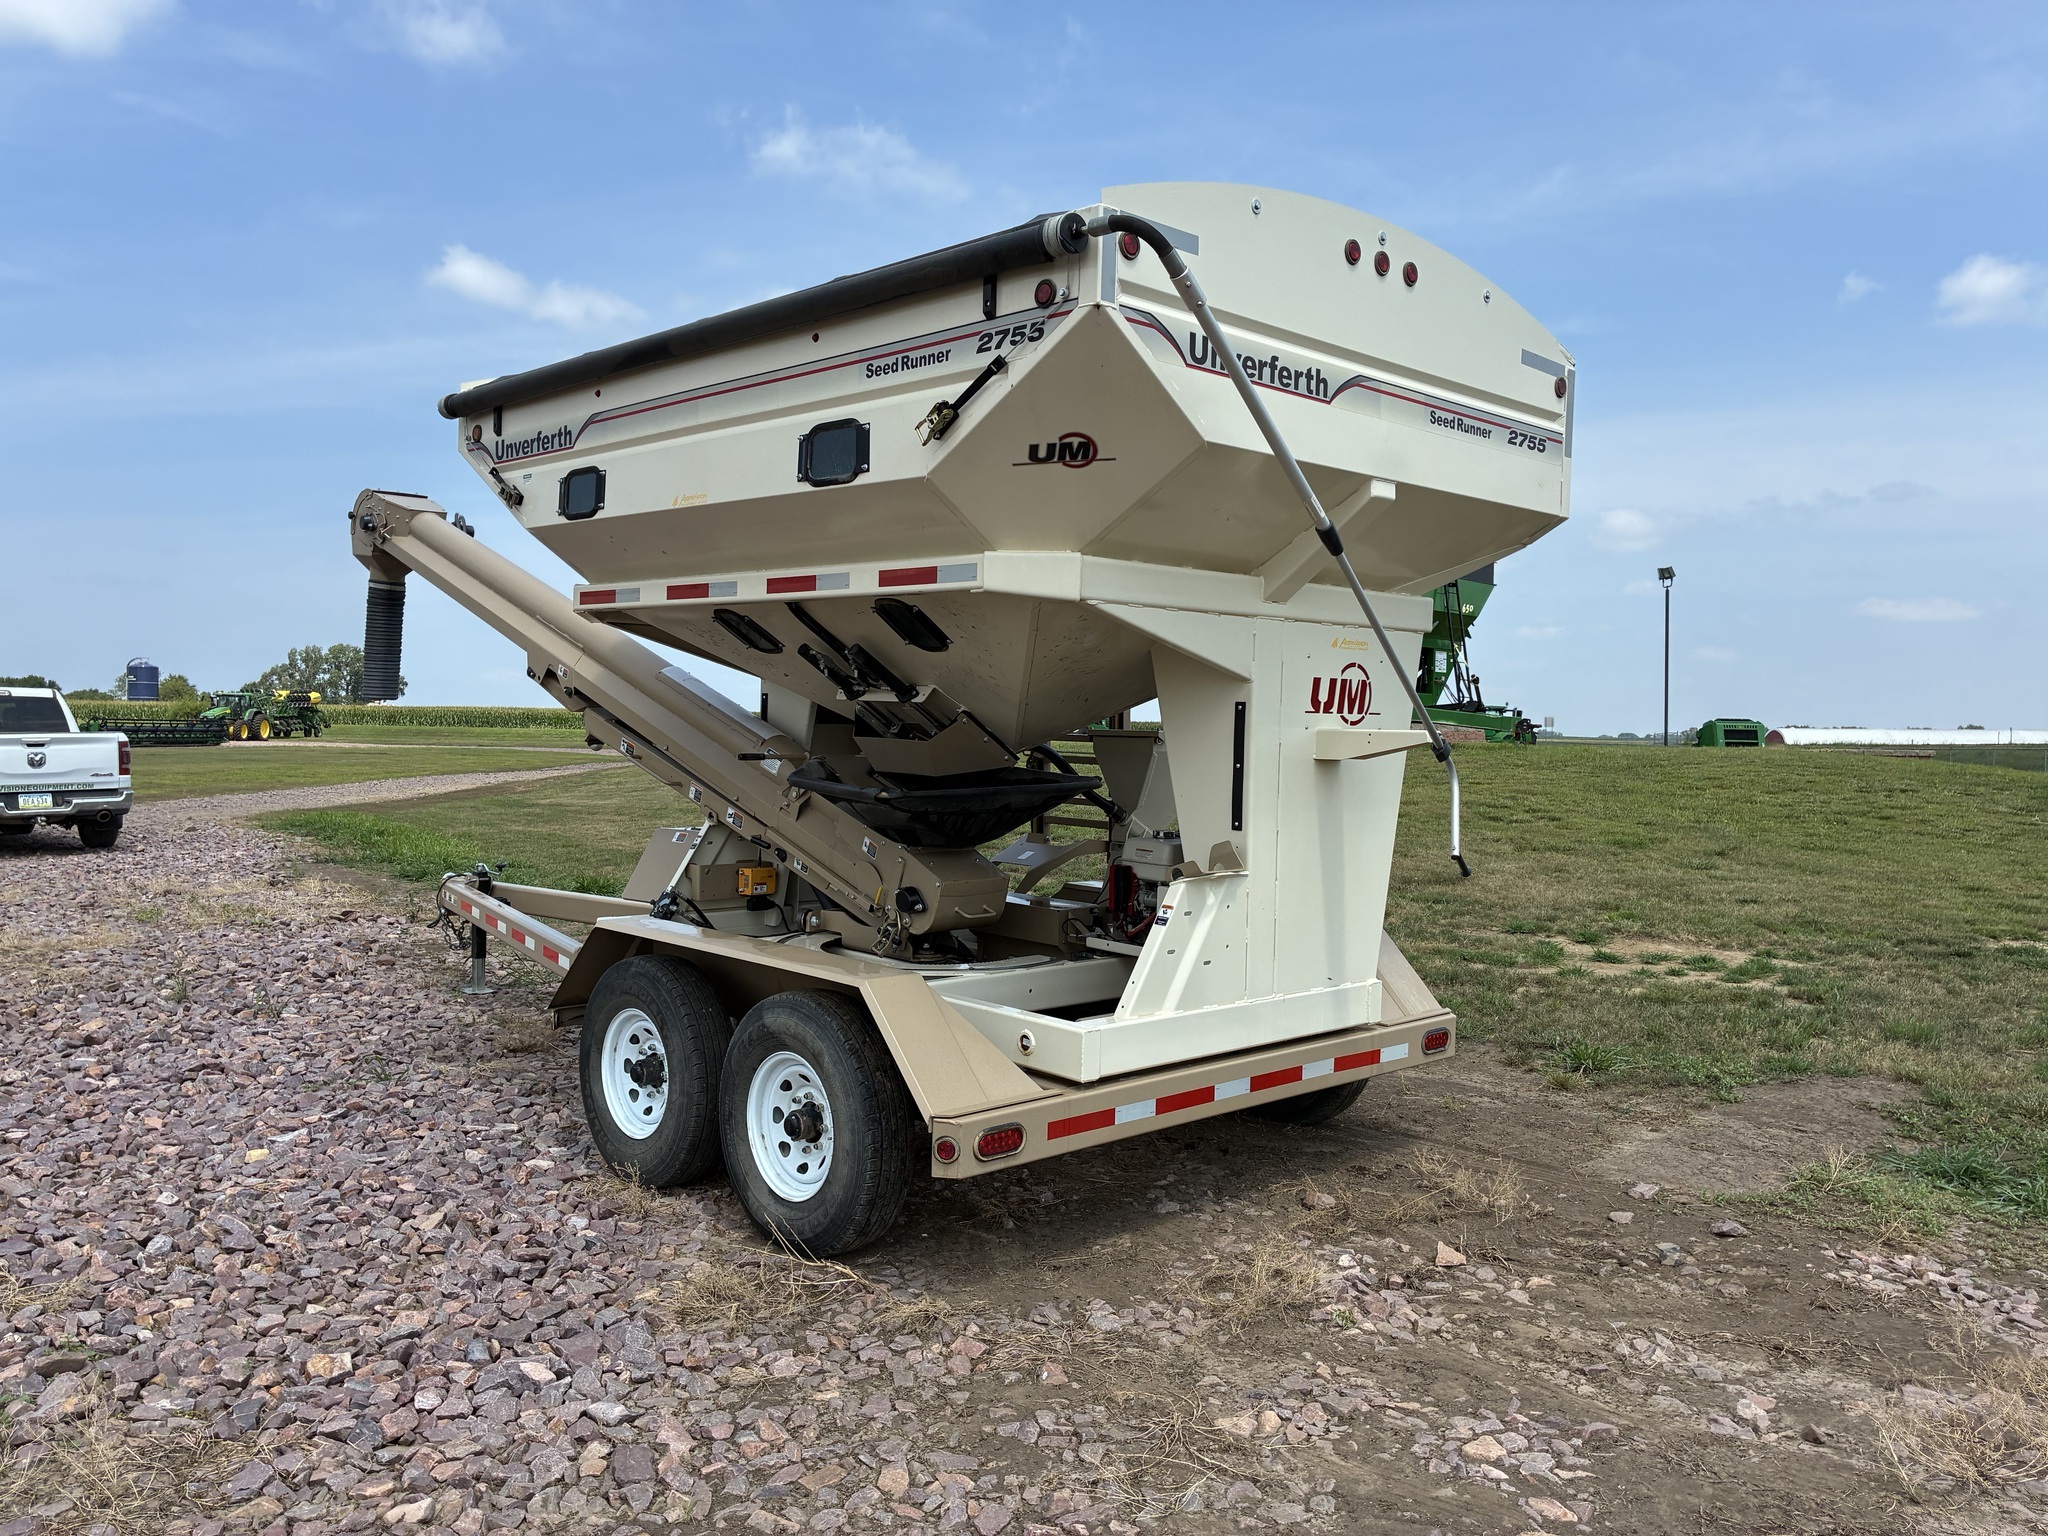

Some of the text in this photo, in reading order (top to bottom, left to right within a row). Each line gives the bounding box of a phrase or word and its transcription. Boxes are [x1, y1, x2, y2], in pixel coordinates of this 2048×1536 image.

[976, 320, 1046, 354] 2755
[865, 348, 952, 379] Seed Runner
[1189, 331, 1329, 399] Unerferth
[1429, 410, 1492, 440] Seed Runner
[494, 425, 573, 462] Unverferth
[1028, 439, 1094, 464] UM
[1507, 429, 1547, 453] 2755
[1461, 603, 1474, 614] 650
[1309, 671, 1369, 718] UM
